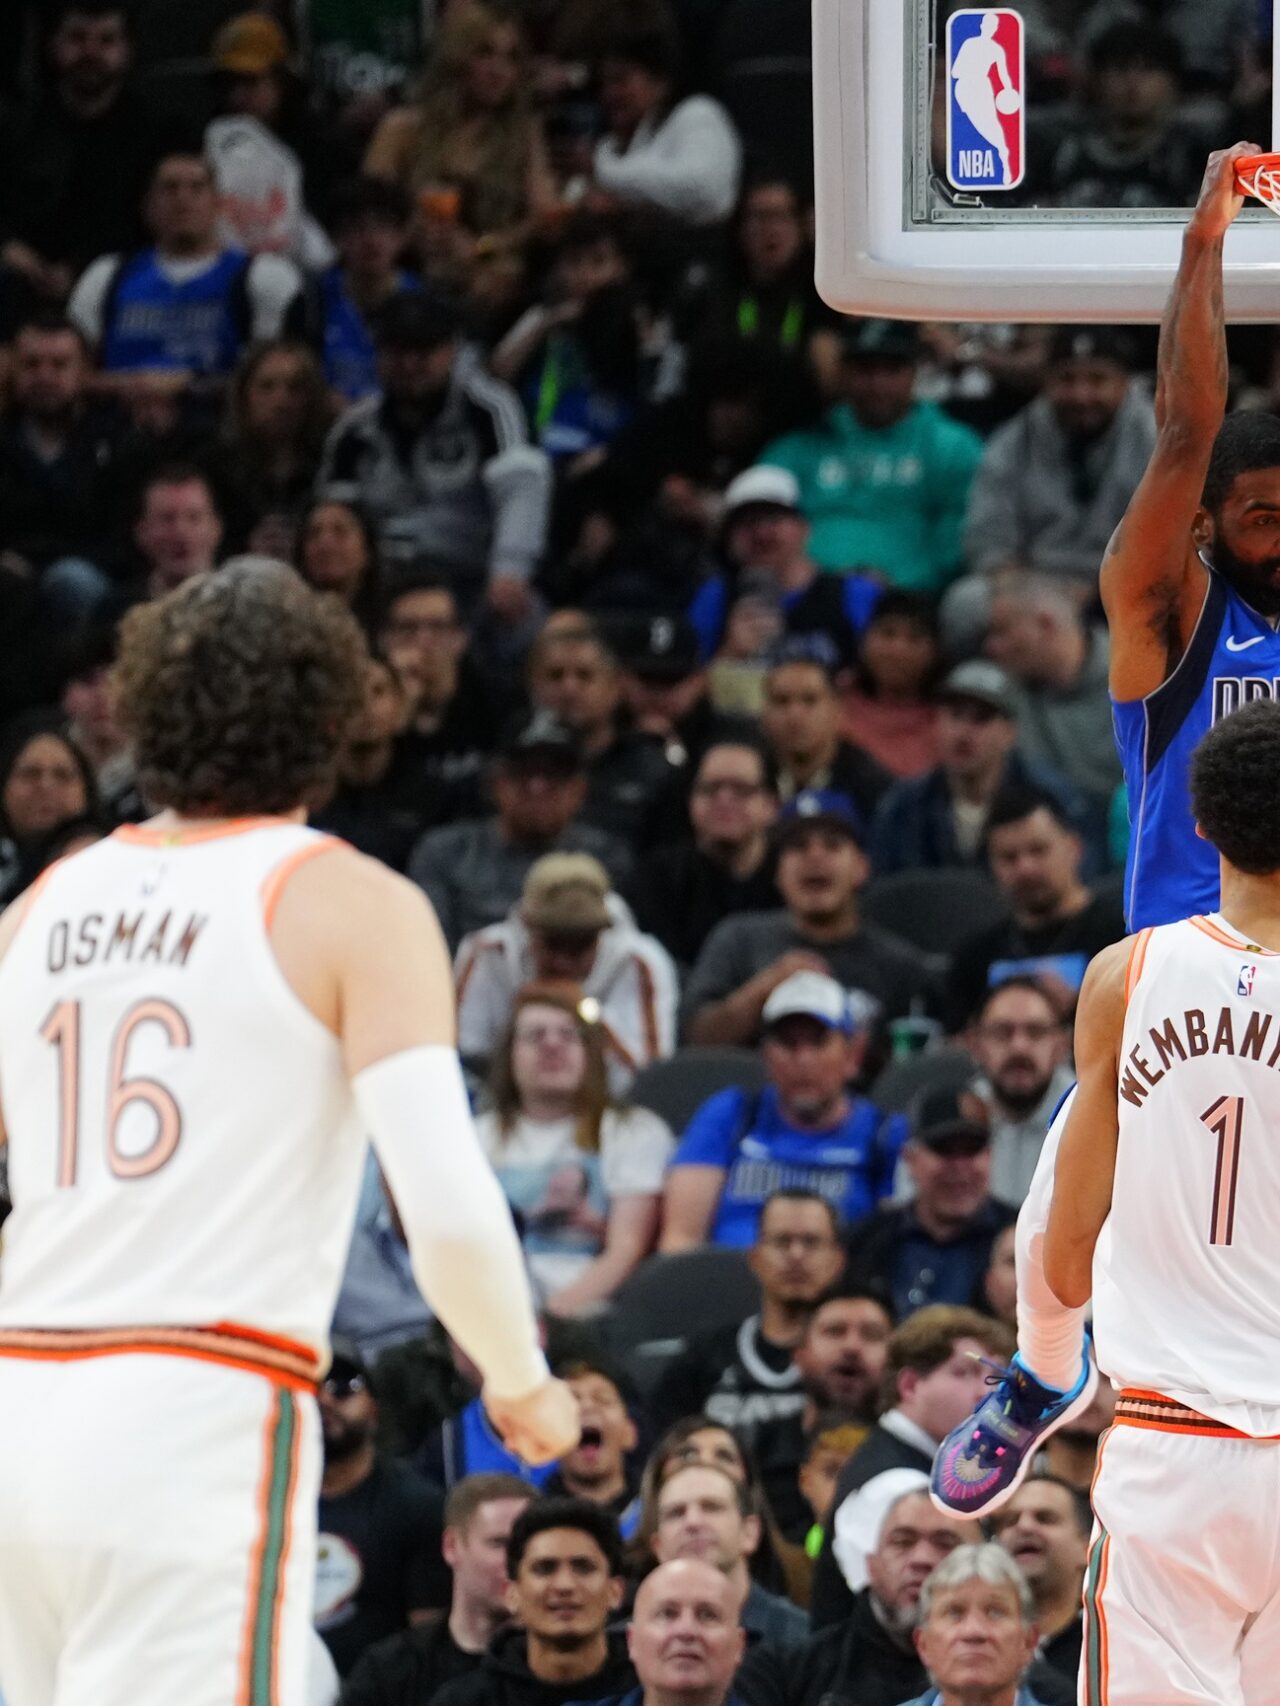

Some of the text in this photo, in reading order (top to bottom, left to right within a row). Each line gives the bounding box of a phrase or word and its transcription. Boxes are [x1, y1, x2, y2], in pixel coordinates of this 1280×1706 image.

[958, 149, 995, 179] NBA
[47, 908, 209, 974] OSMAN
[39, 996, 192, 1189] 16
[1199, 1095, 1245, 1246] 1
